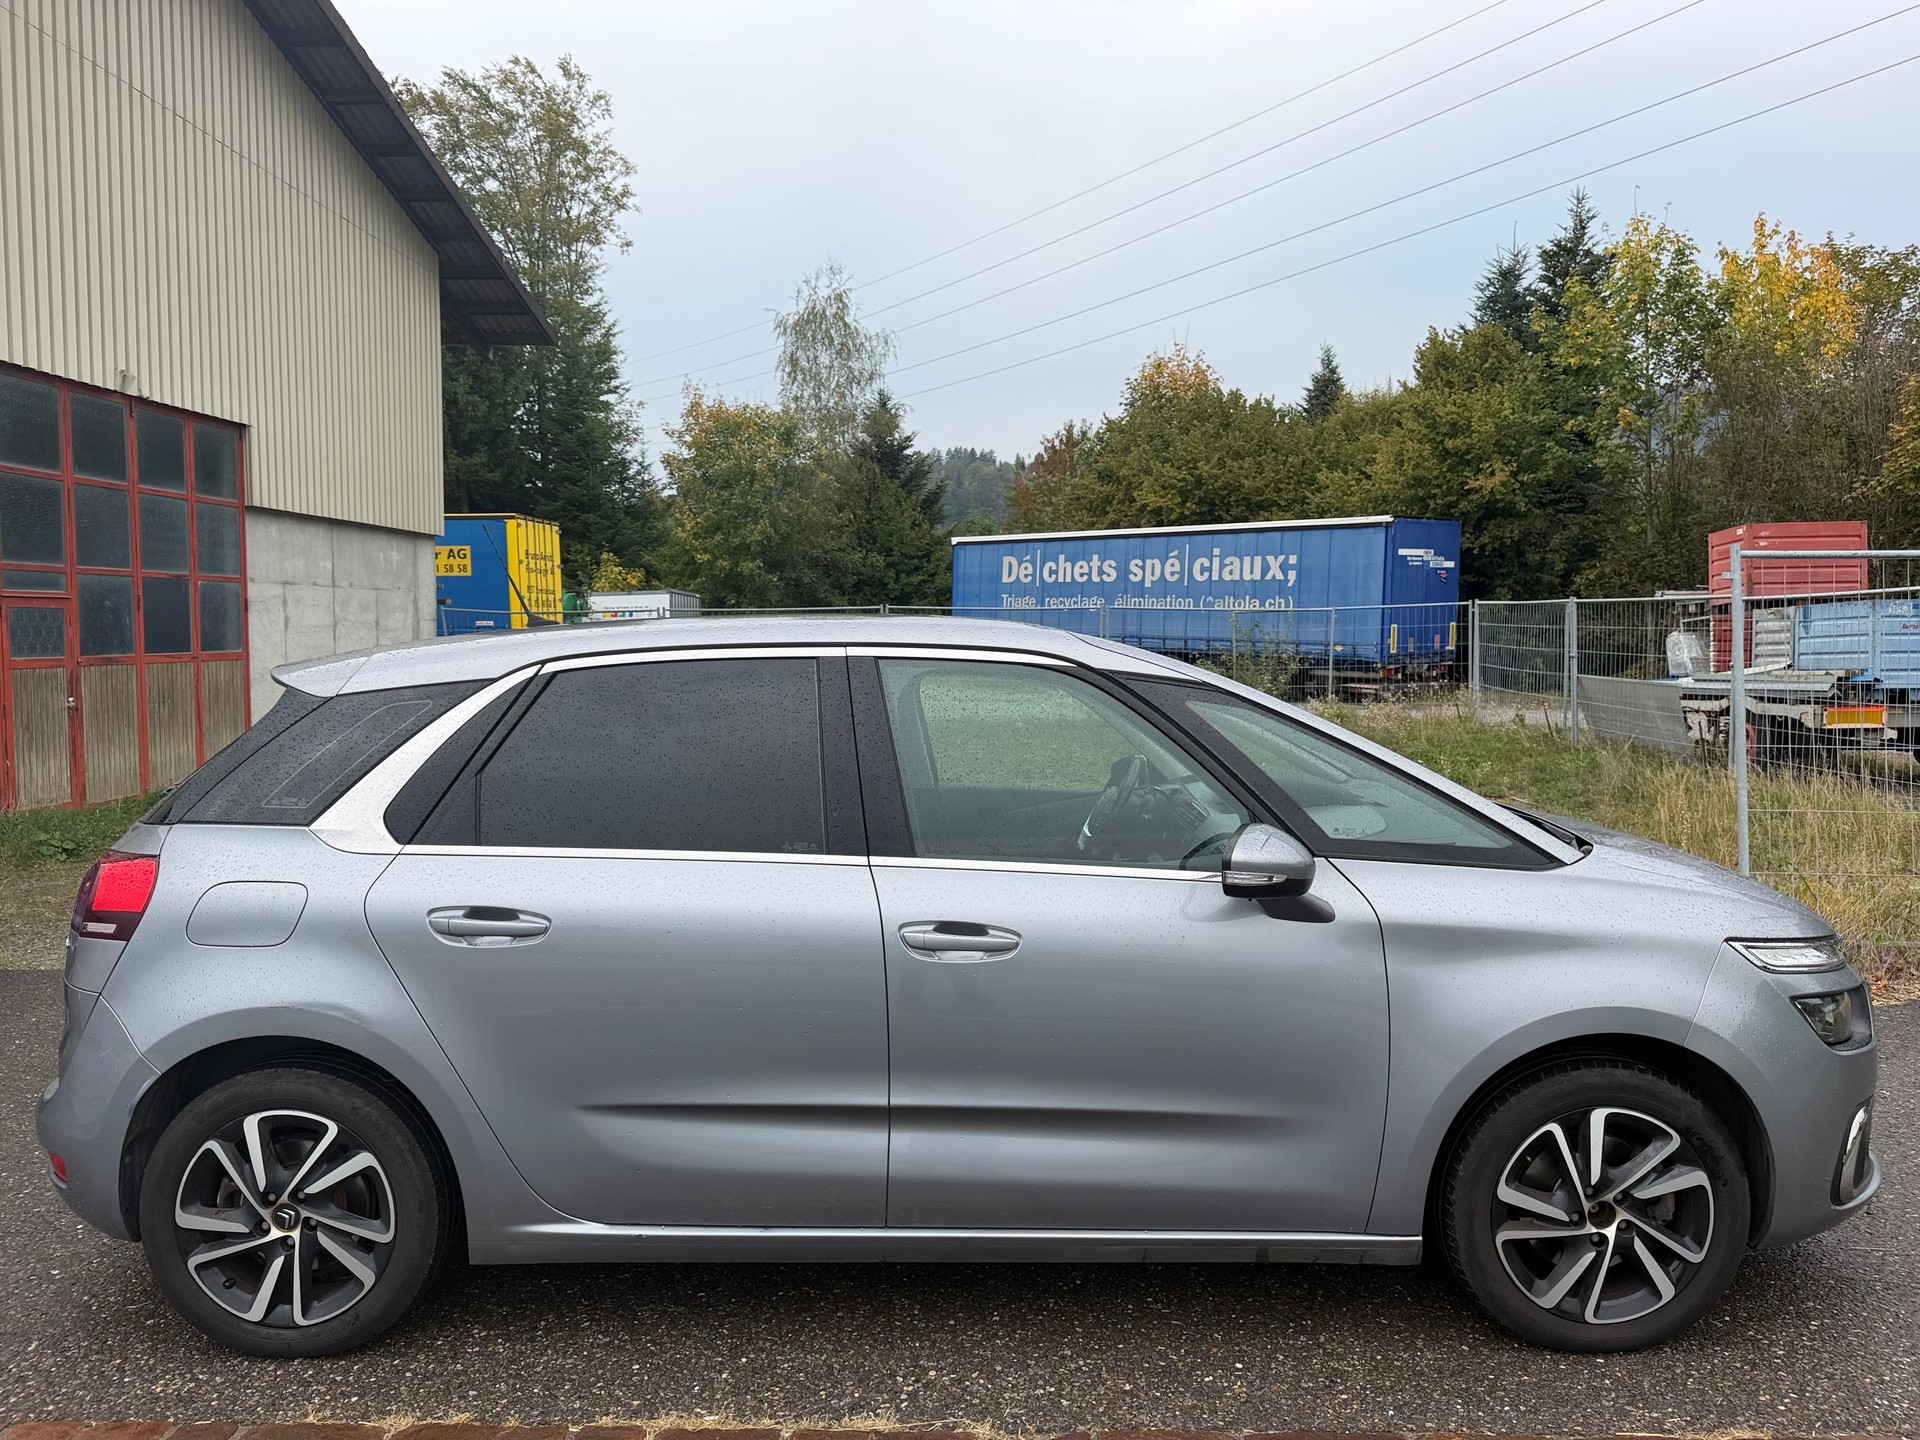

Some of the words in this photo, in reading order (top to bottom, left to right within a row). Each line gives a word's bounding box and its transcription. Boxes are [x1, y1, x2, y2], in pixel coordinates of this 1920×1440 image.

[447, 548, 467, 560] AG
[444, 563, 454, 573] 58
[457, 563, 468, 573] 58
[1114, 593, 1194, 608] élimination
